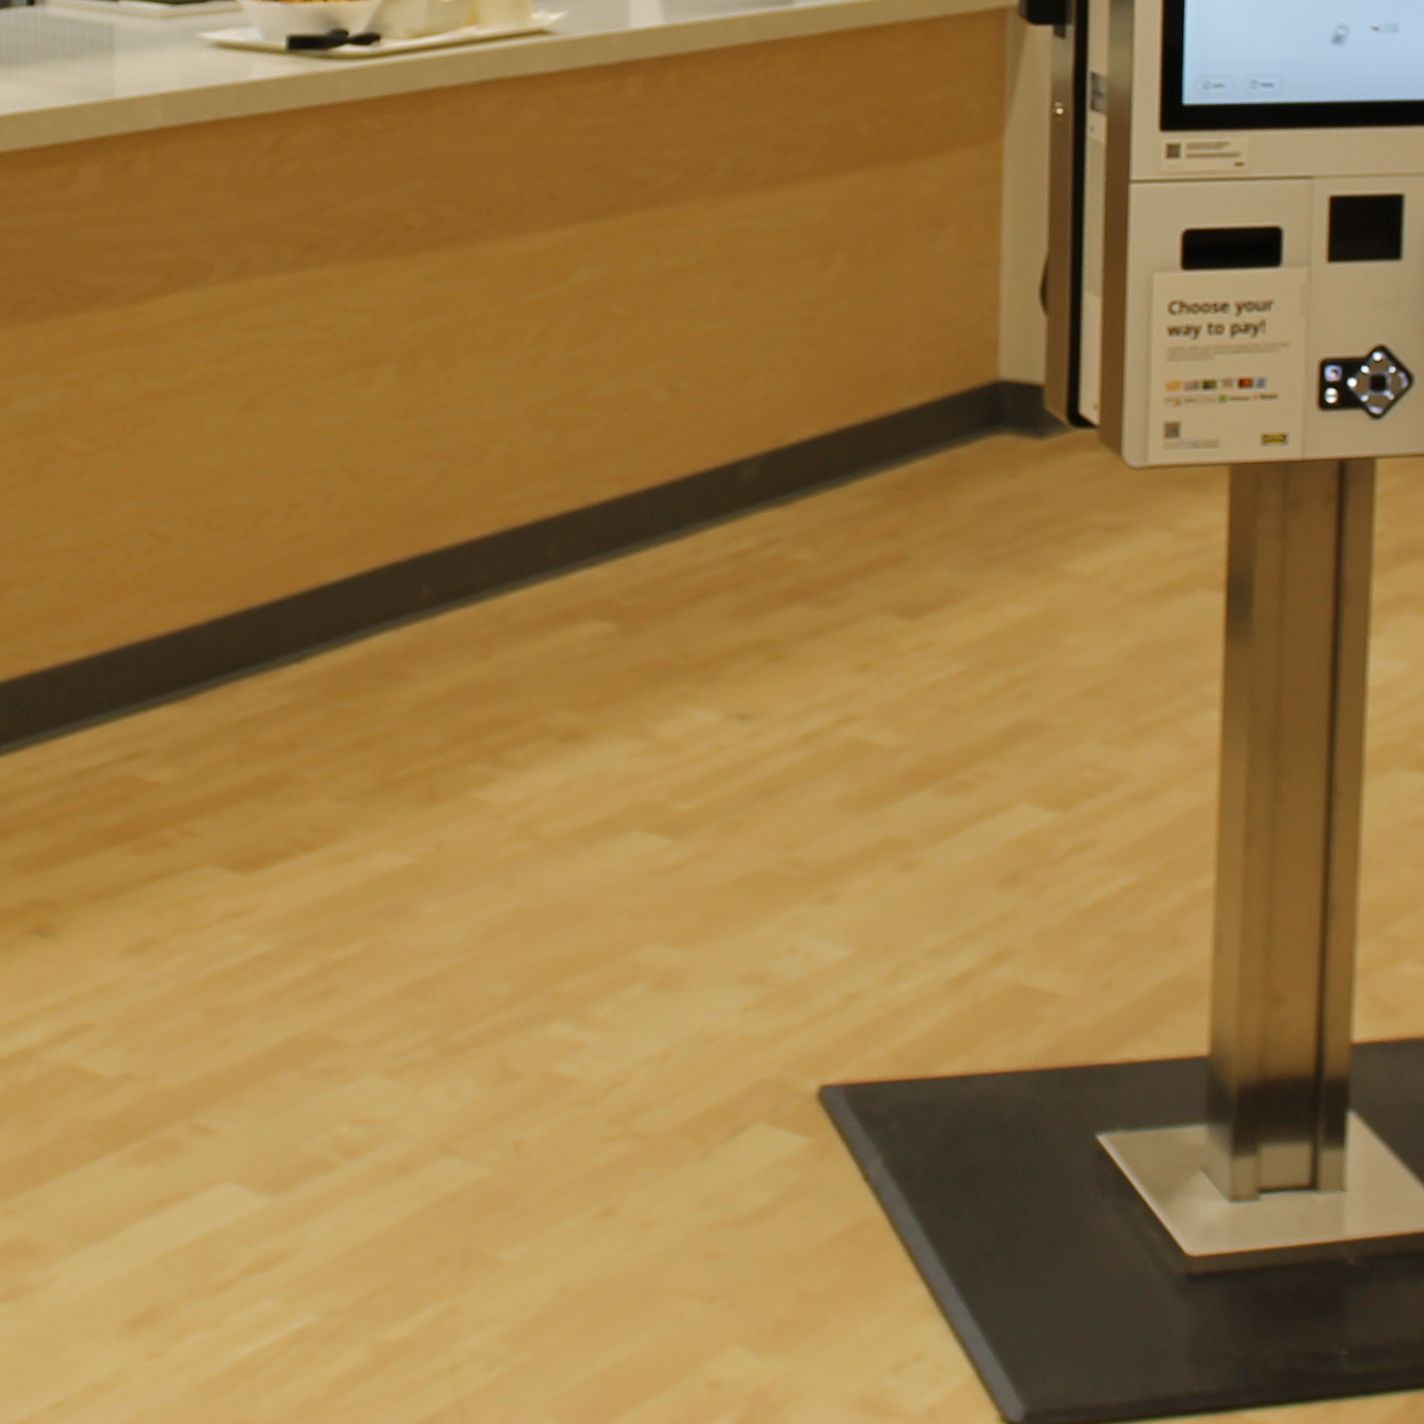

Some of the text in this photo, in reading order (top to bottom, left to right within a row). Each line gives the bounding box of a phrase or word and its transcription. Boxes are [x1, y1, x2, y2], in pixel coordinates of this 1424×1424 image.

[1168, 300, 1274, 317] Choose your
[1167, 320, 1266, 340] way to pay!
